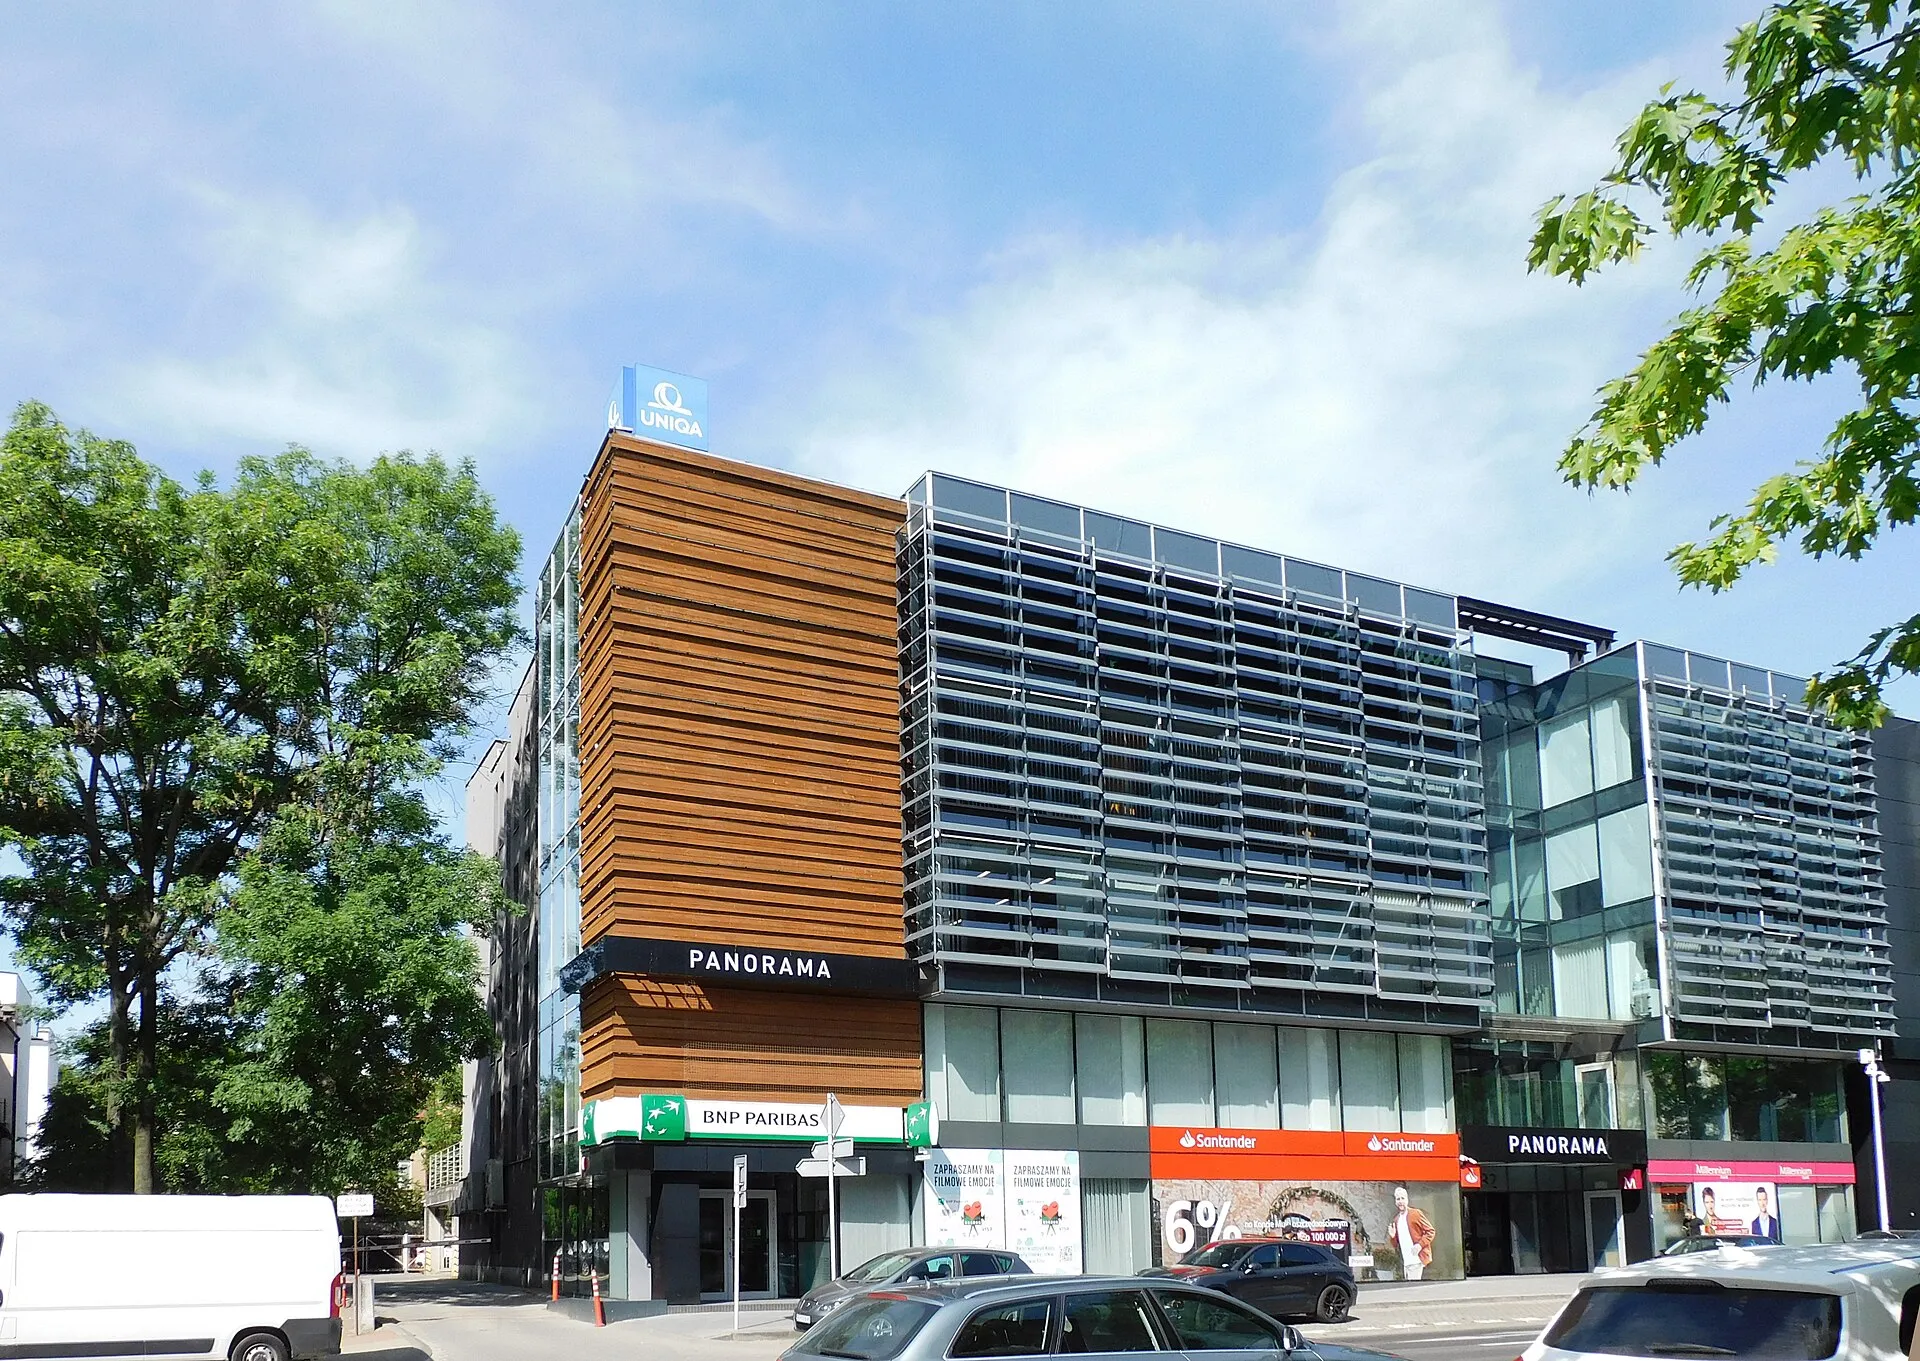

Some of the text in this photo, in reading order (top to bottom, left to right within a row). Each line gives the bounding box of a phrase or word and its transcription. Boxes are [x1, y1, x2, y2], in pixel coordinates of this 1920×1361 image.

[640, 408, 703, 438] UNIQA
[689, 949, 832, 979] PANORAMA
[703, 1110, 819, 1127] BNP PARIBAS
[1196, 1133, 1257, 1149] Santander
[1382, 1138, 1435, 1152] Santander
[1508, 1135, 1608, 1155] PANORAMA
[933, 1163, 995, 1175] ZAPRASZAMY NA
[1013, 1165, 1071, 1176] ZAPRASZAMY NA
[933, 1176, 995, 1187] FILMOWE EMOCJE
[1013, 1177, 1071, 1188] FILMOWE EMOCJE
[1165, 1199, 1242, 1254] 6%
